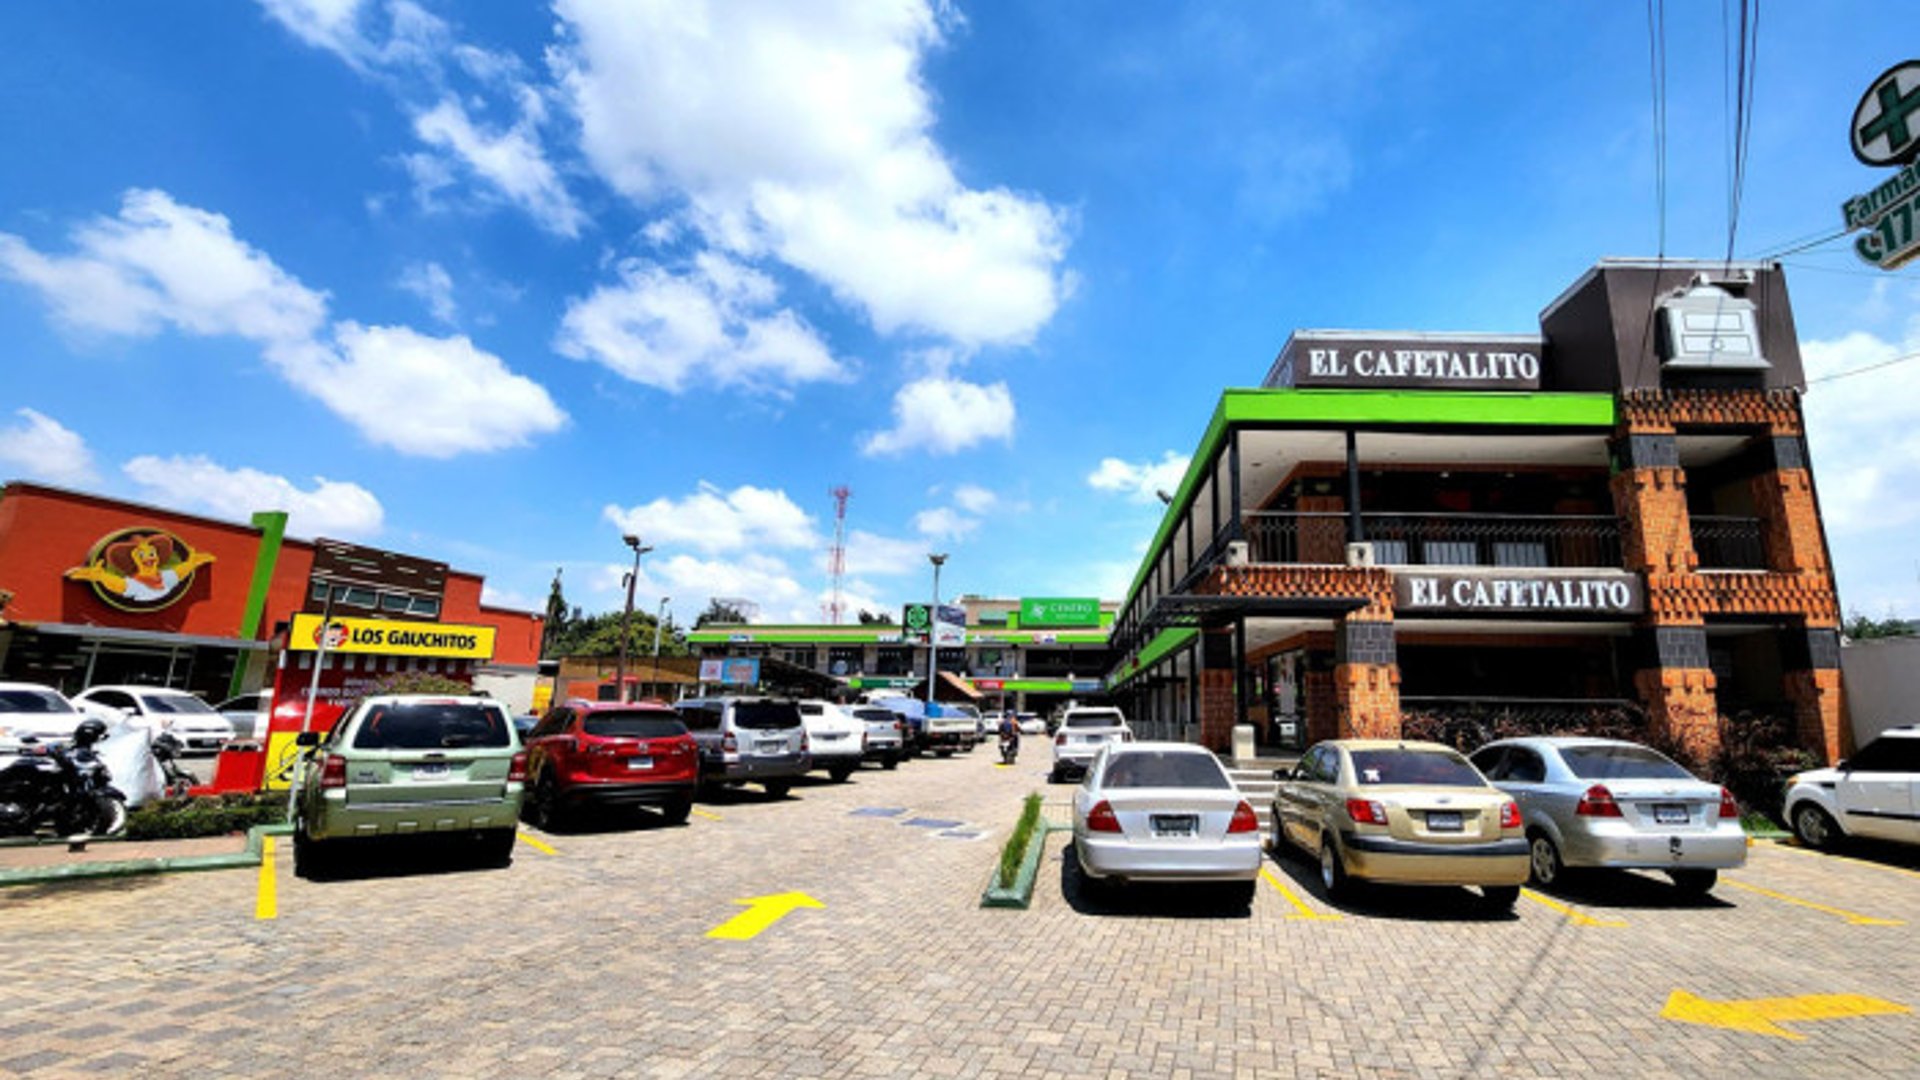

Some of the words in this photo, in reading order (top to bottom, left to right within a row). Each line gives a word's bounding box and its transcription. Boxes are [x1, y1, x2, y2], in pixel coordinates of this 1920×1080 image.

[1309, 349, 1347, 376] EL
[1353, 350, 1540, 380] CAFETALITO
[1410, 578, 1446, 606] EL
[1452, 580, 1630, 609] CAFETALITO
[352, 629, 384, 645] LOS
[387, 630, 477, 650] GAUCHITOS
